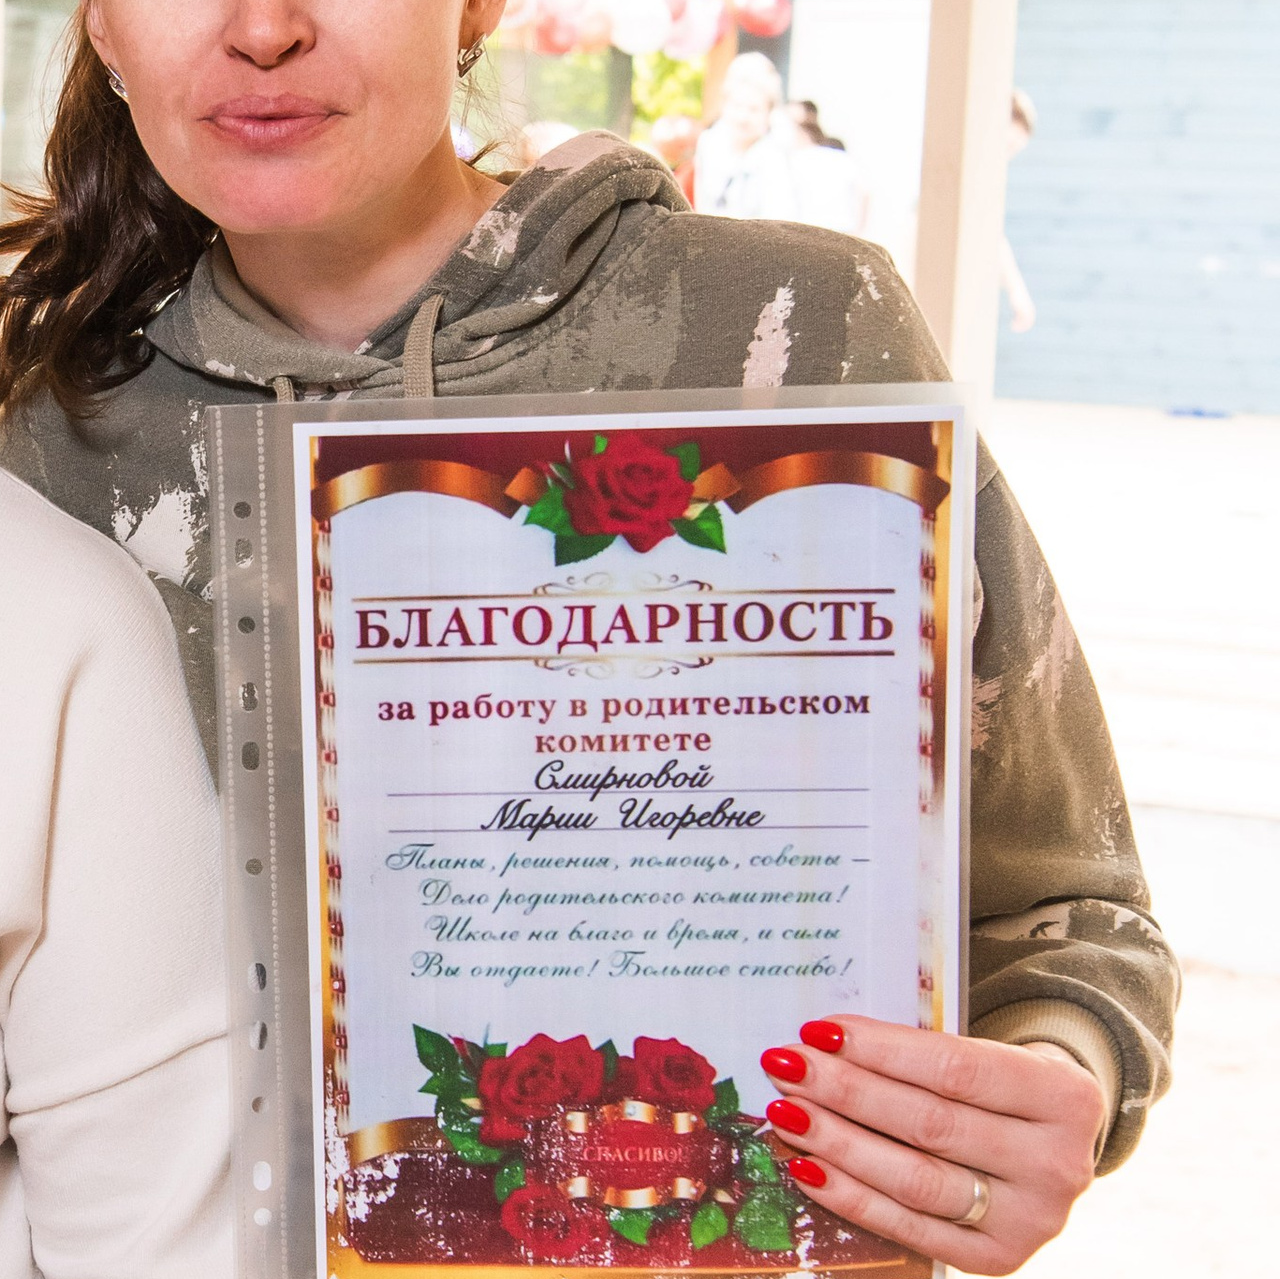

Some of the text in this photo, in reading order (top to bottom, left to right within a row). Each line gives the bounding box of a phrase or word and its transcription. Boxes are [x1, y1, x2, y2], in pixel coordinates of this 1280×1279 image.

[355, 602, 893, 653] БЛАГОДАРНОСТЬ
[378, 693, 870, 725] за работу в родительском
[535, 732, 711, 753] комитете
[535, 759, 714, 800] Смирновой
[481, 797, 765, 840] Марии Игоревне
[385, 843, 496, 871] Планы,
[499, 852, 619, 876] решения,
[630, 854, 740, 872] помощь,
[749, 844, 841, 867] советы
[420, 878, 850, 915] Дело родительского комитета!
[425, 915, 841, 949] Школе на благо и время, и силы
[410, 950, 853, 987] Вы отдаете! Большое спасибо!
